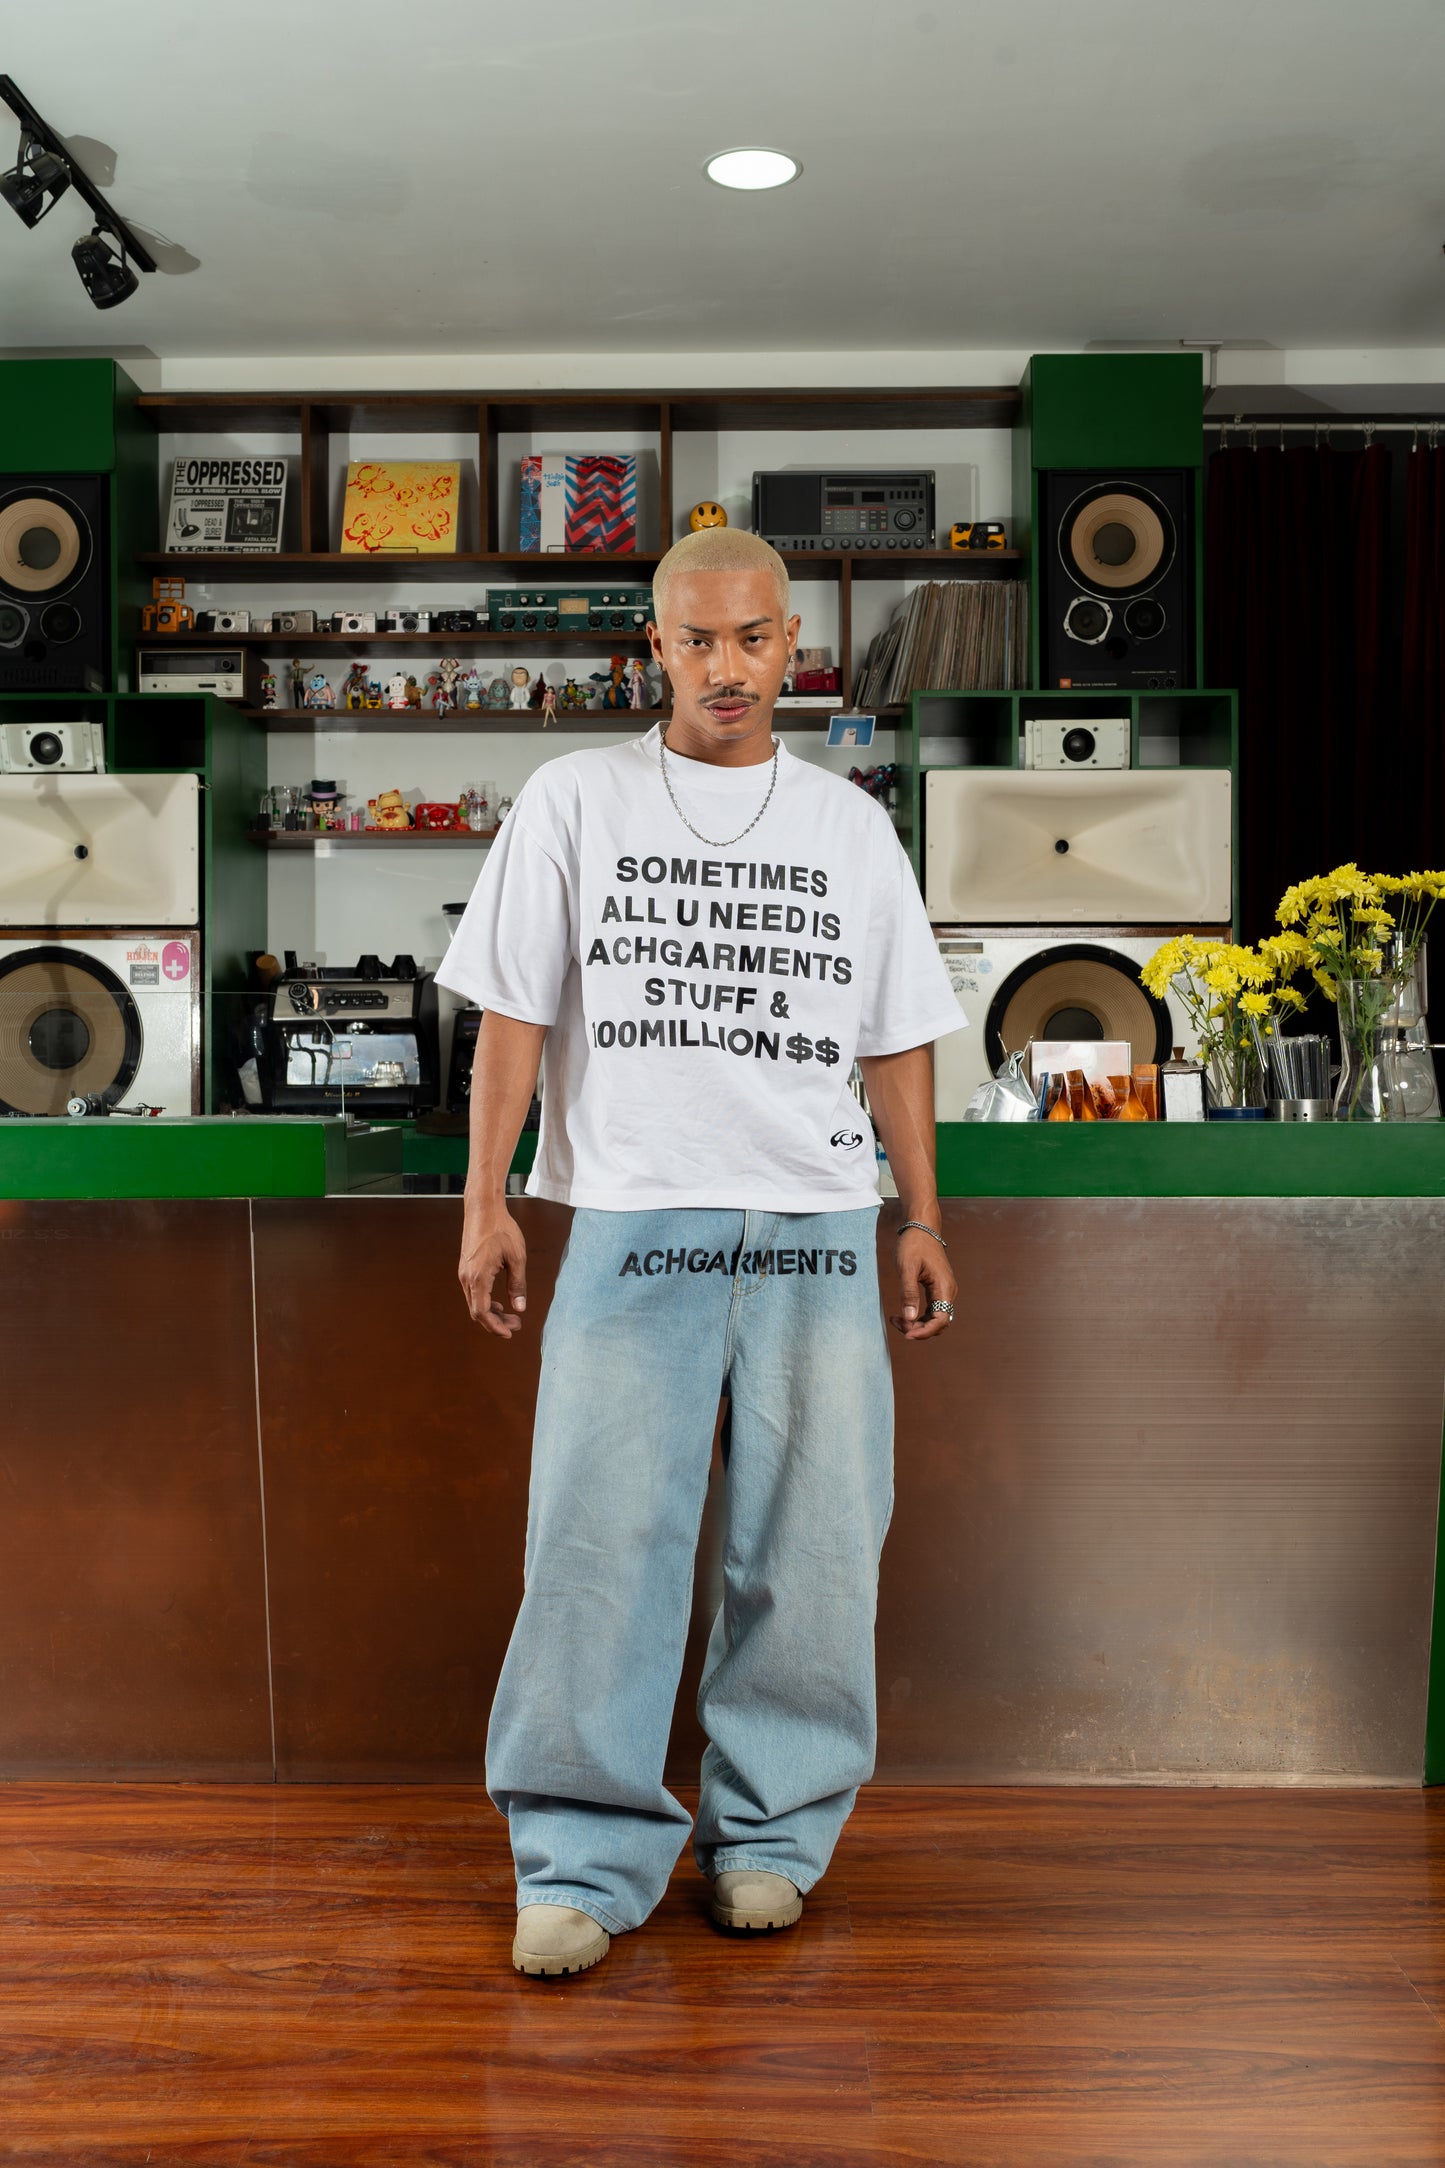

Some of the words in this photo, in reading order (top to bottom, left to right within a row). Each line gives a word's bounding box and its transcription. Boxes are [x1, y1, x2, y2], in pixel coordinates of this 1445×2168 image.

[175, 460, 186, 485] THE
[187, 460, 285, 486] OPPRESSED
[194, 499, 225, 508] OPPRESSED
[616, 856, 828, 898] SOMETIMES
[601, 895, 667, 925] ALL
[676, 898, 699, 927] U
[709, 901, 806, 934] NEED
[812, 910, 841, 941] IS
[586, 936, 853, 985] ACHGARMENTS
[644, 977, 758, 1014] STUFF
[769, 990, 790, 1020] &
[785, 1032, 840, 1068] $$
[618, 1247, 858, 1278] ACHGARMENTS
